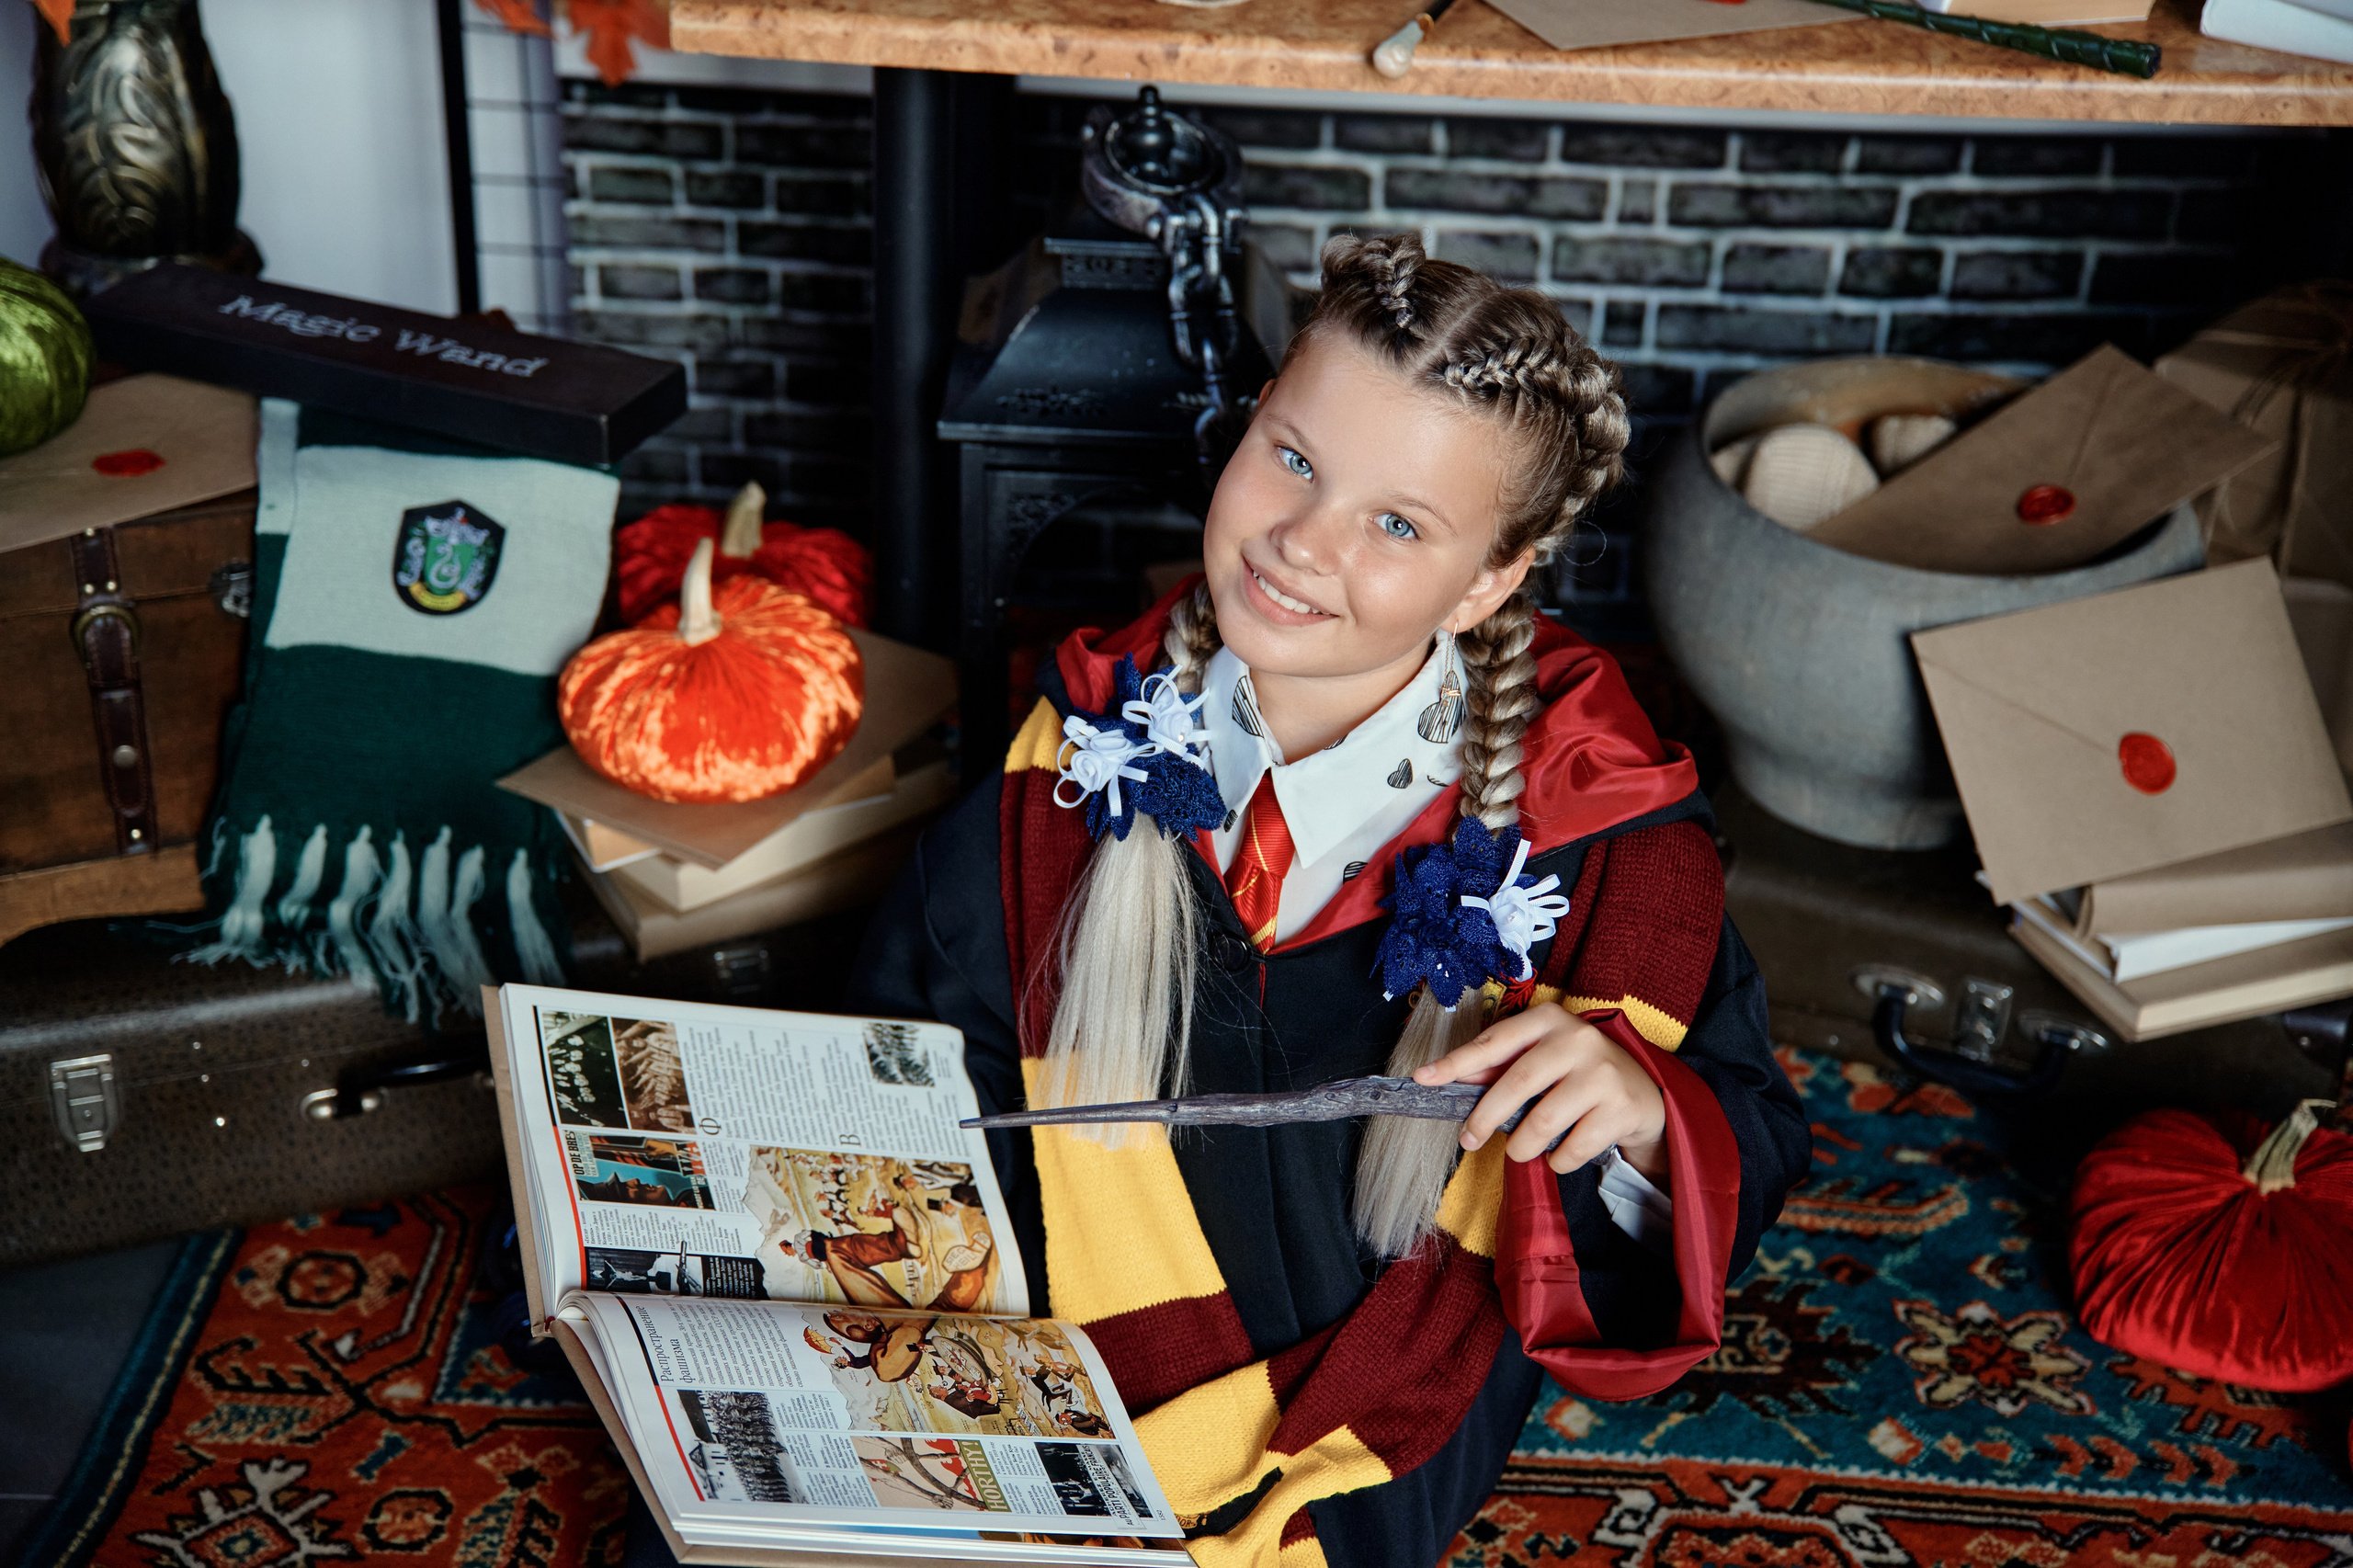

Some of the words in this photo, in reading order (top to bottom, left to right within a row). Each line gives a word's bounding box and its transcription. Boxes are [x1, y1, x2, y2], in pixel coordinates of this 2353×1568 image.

[218, 294, 382, 343] Magic
[393, 328, 550, 378] Wand
[697, 1117, 722, 1136] Ф
[568, 1152, 582, 1163] DE
[571, 1163, 585, 1175] OP
[634, 1305, 675, 1381] Распространение
[667, 1338, 695, 1383] фашизма
[960, 1440, 1008, 1509] HORTHY!
[1091, 1467, 1119, 1498] POPULAIRE
[1109, 1499, 1130, 1518] PARTI
